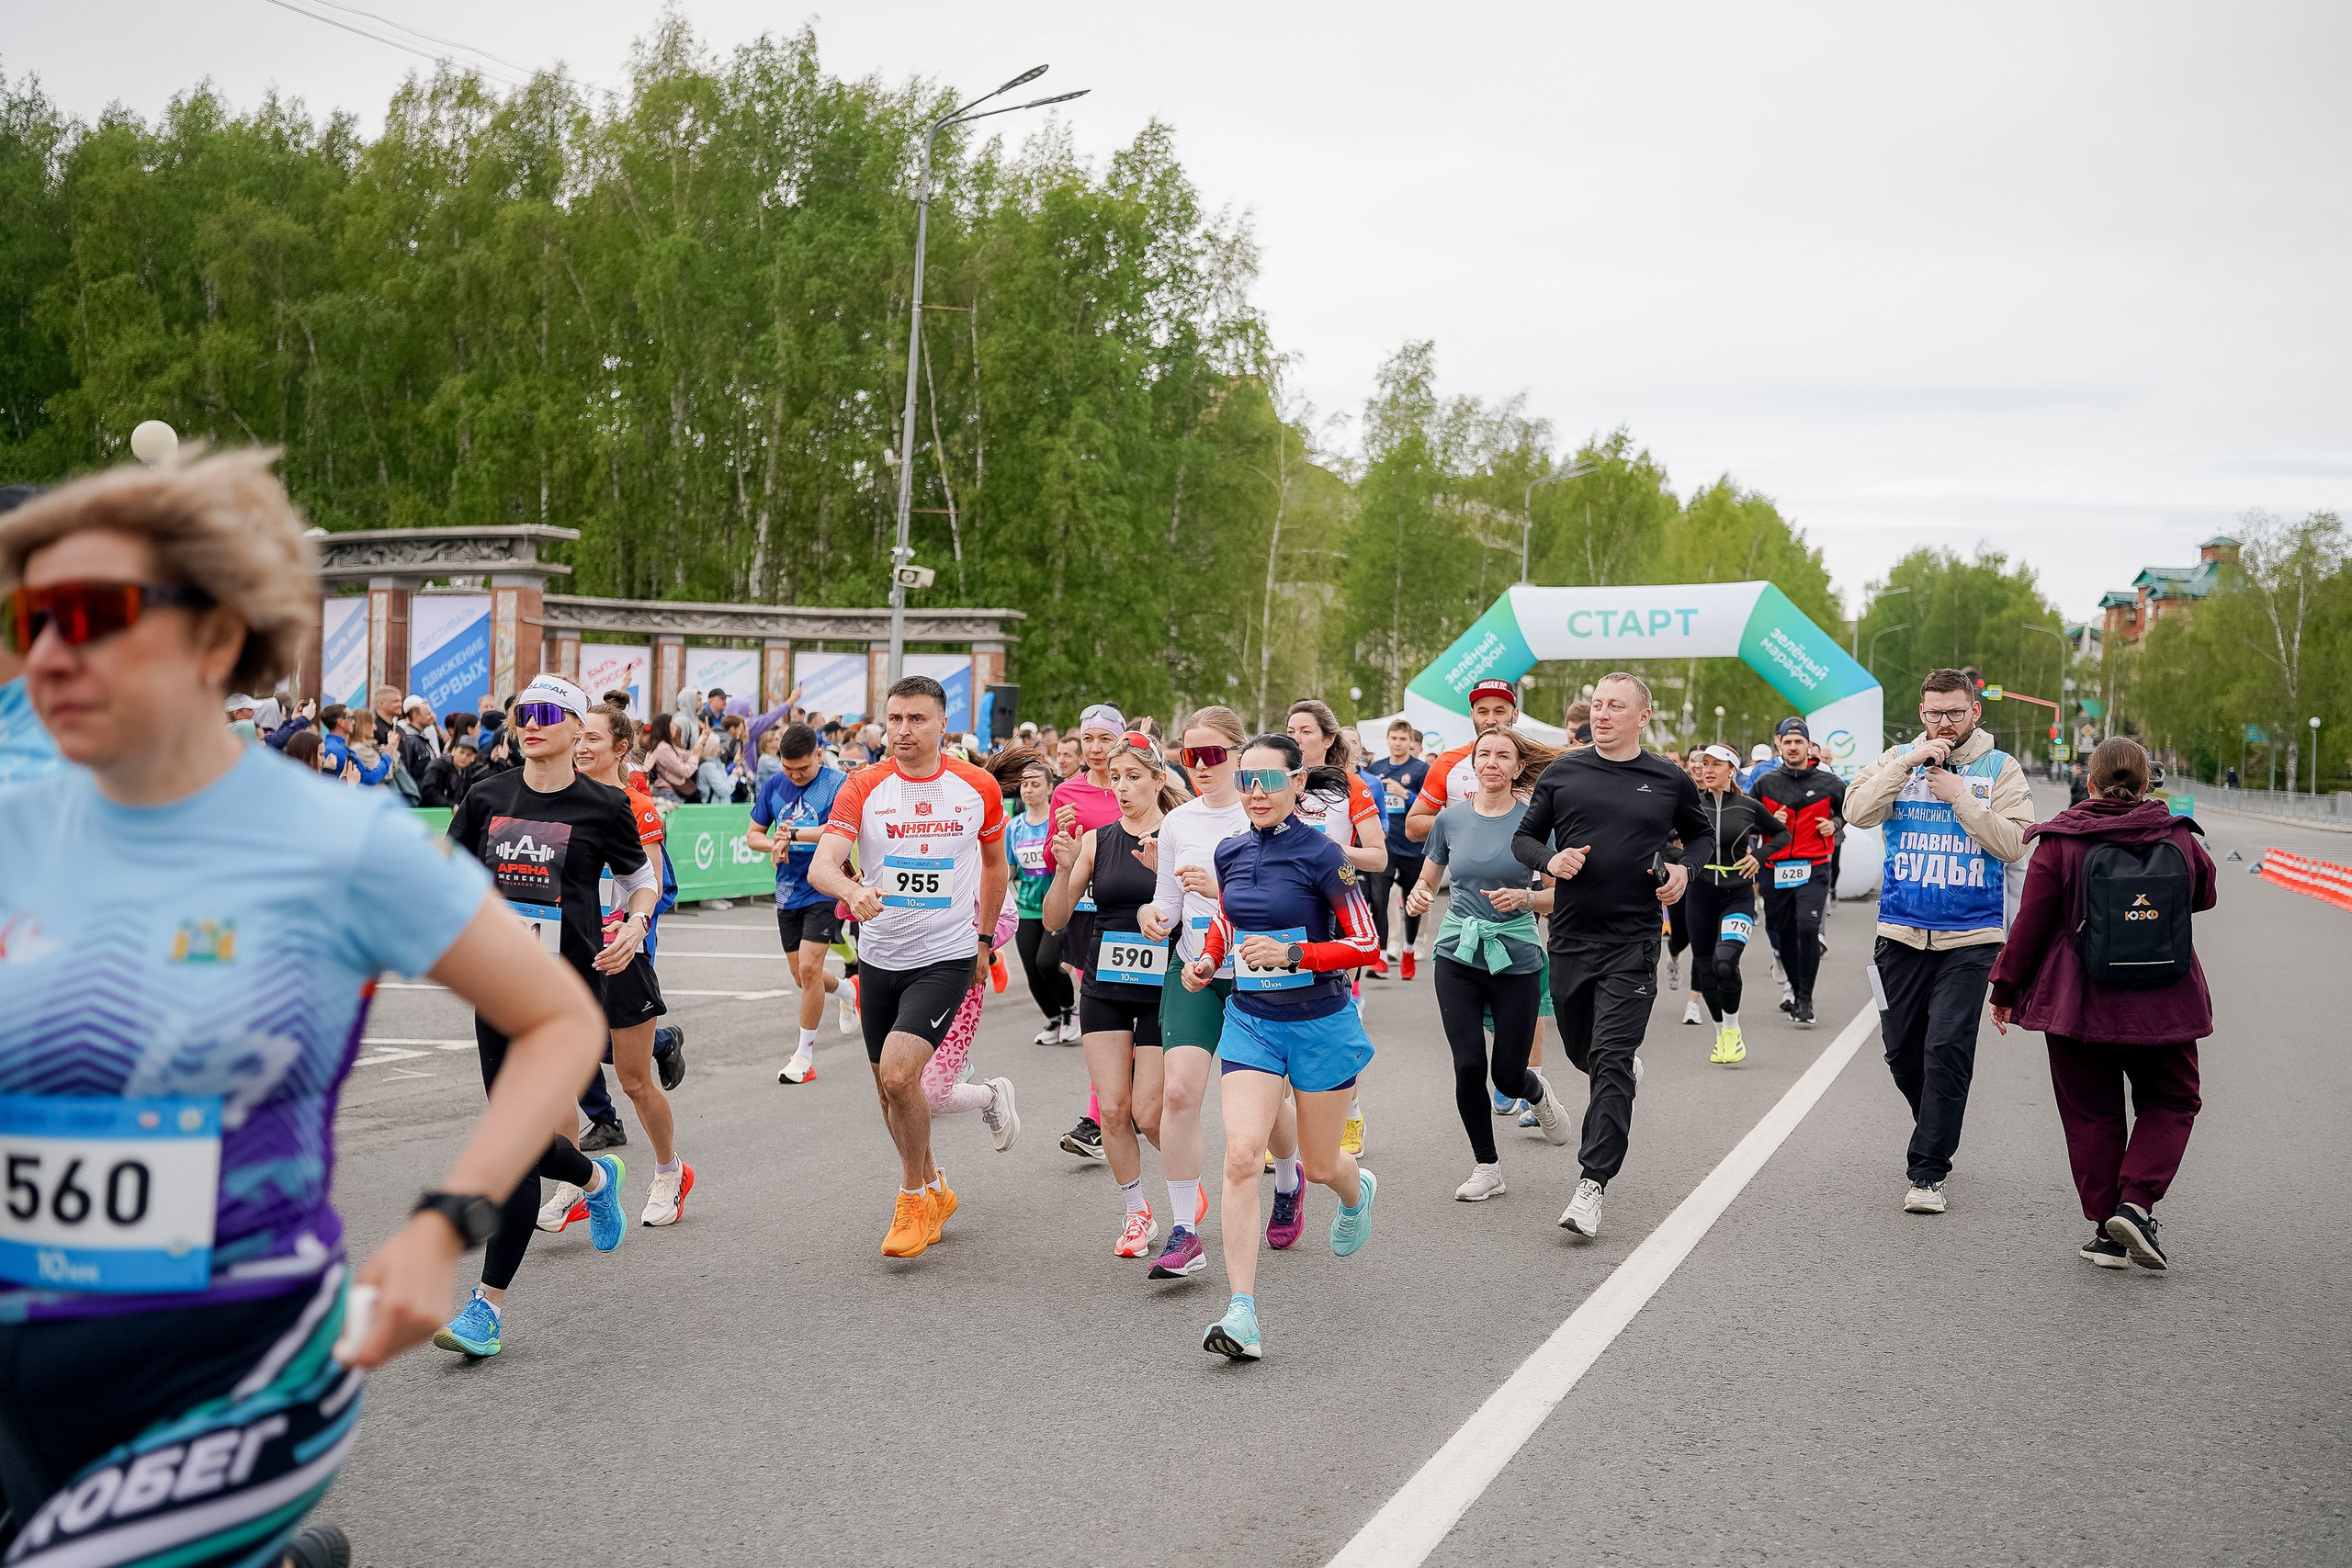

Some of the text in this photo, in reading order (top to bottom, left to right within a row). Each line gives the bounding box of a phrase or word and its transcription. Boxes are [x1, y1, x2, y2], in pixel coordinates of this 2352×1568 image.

[1566, 608, 1699, 638] СТАРТ
[422, 636, 487, 692] ДВИЖЕНИЕ
[1444, 630, 1498, 684] зелёный
[1760, 637, 1817, 691] марафон
[1770, 627, 1830, 681] зелёный
[587, 658, 617, 679] БЫТЬ
[697, 658, 729, 679] БЫТЬ
[1453, 642, 1506, 694] марафон
[423, 657, 488, 710] ЕРВЫХ
[905, 822, 964, 833] НЯГАНЬ
[1899, 832, 1983, 854] ГЛАВНЫЙ
[498, 863, 549, 876] АРЕНА
[498, 874, 549, 884] ЖЕНСКИЙ
[1782, 869, 1804, 879] 628
[1894, 852, 1985, 890] СУДЬЯ
[897, 873, 940, 893] 955
[1112, 947, 1153, 969] 590
[1121, 973, 1130, 981] 10
[1260, 979, 1271, 988] 10
[7, 1156, 150, 1227] 560
[38, 1248, 69, 1280] 10
